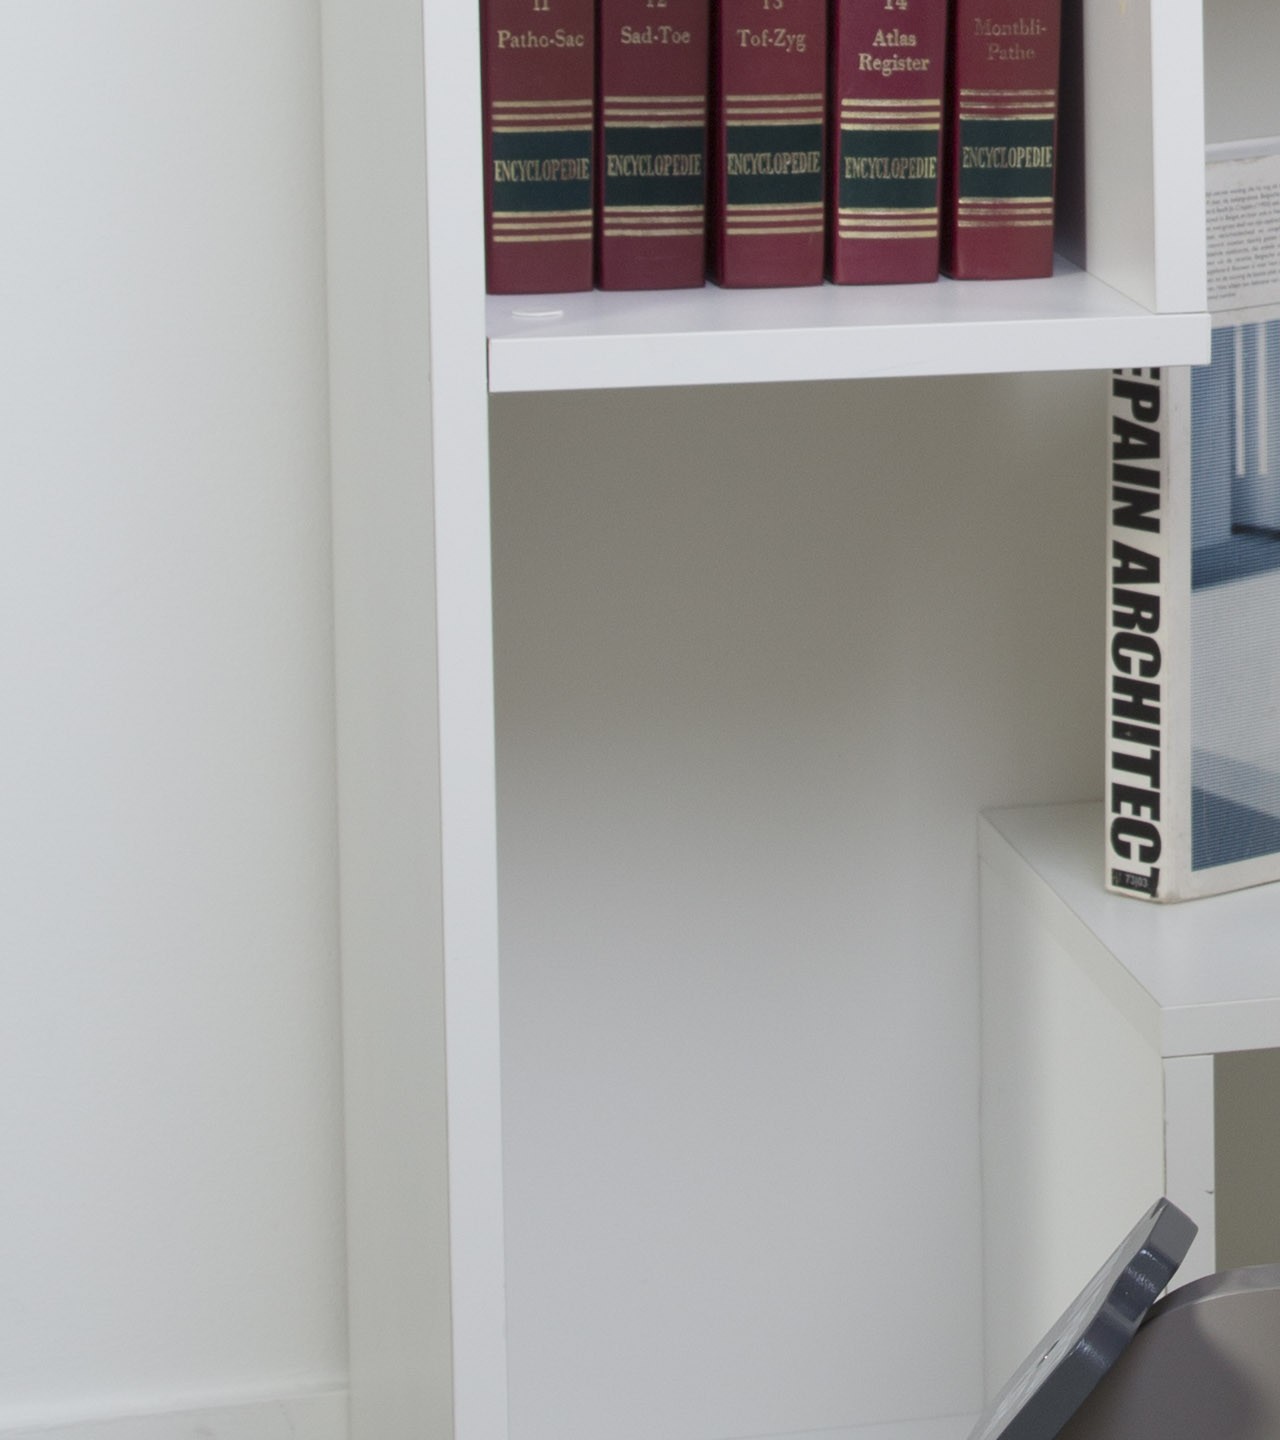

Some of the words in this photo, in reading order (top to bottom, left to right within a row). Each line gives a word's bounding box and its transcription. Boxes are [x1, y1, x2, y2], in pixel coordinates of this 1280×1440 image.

[497, 29, 585, 48] Patho-Sac
[620, 26, 691, 45] Sad-Toe
[736, 28, 806, 53] Tof-Zyg
[872, 29, 917, 47] Atlas
[858, 53, 930, 77] Register
[607, 154, 702, 177] ENCYCLOPEDIE
[726, 151, 821, 176] ENCYCLOPEDIE
[845, 156, 937, 180] ENCYCLOPEDIE
[962, 145, 1053, 169] ENCYCLOPEDIE
[494, 157, 590, 182] ENCYCLOPEDIE
[1110, 540, 1161, 897] ARCHITECT
